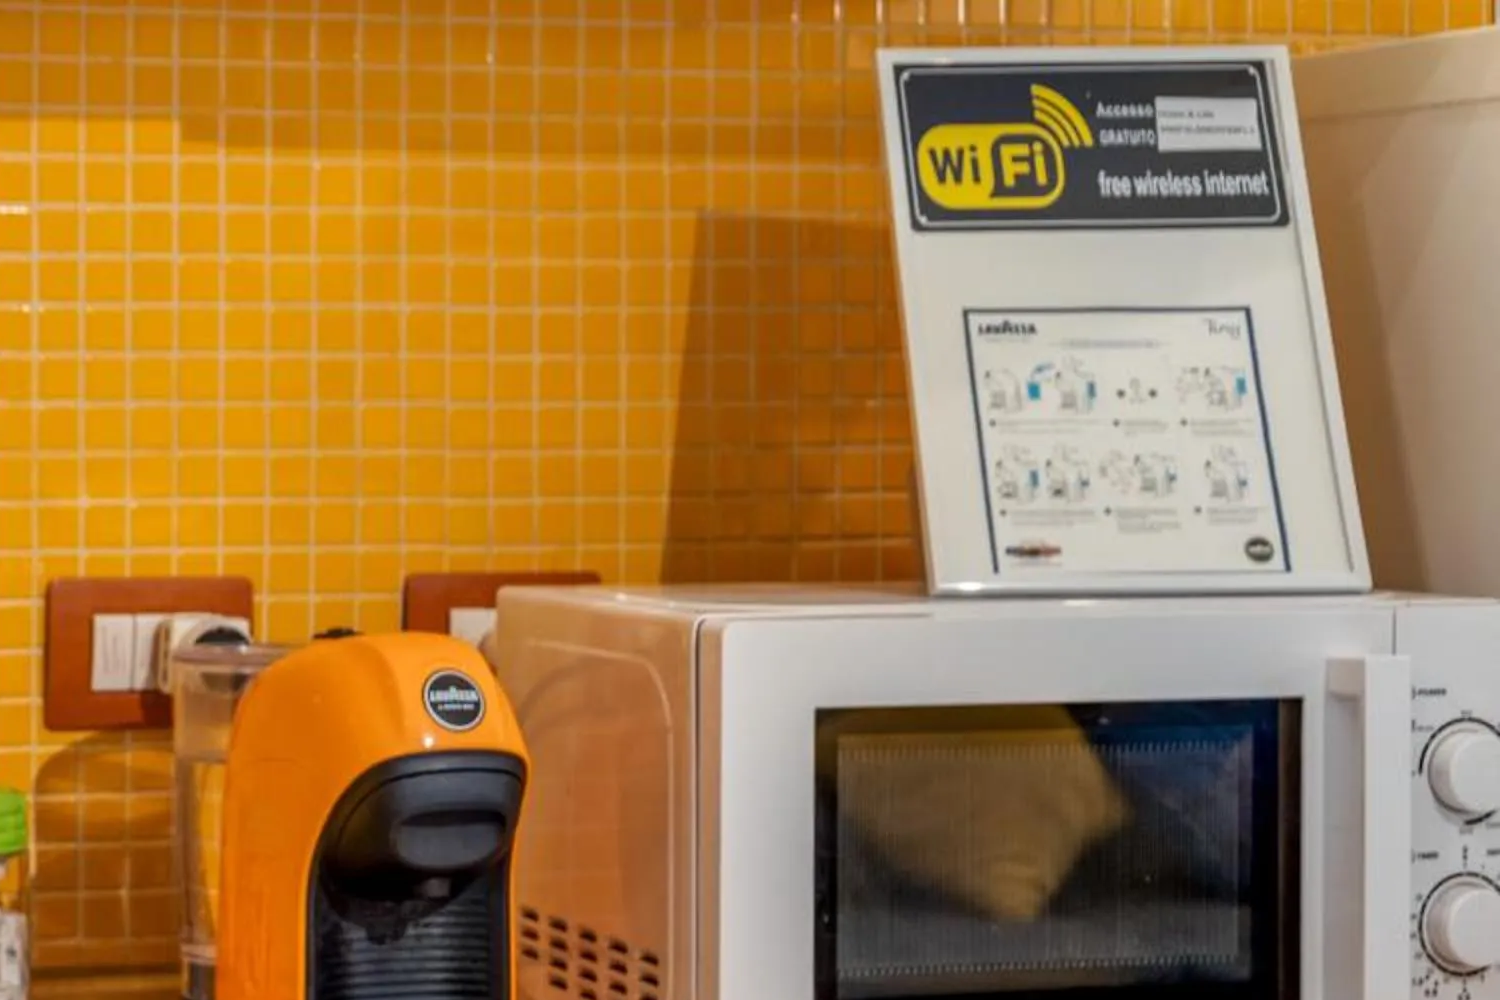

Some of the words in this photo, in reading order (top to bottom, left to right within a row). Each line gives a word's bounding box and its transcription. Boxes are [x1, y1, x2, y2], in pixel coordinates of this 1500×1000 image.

[1096, 101, 1154, 119] Accesso
[1099, 128, 1155, 146] GRATUITO
[1098, 169, 1132, 197] free
[1132, 168, 1202, 197] wireless
[1203, 169, 1269, 197] internet
